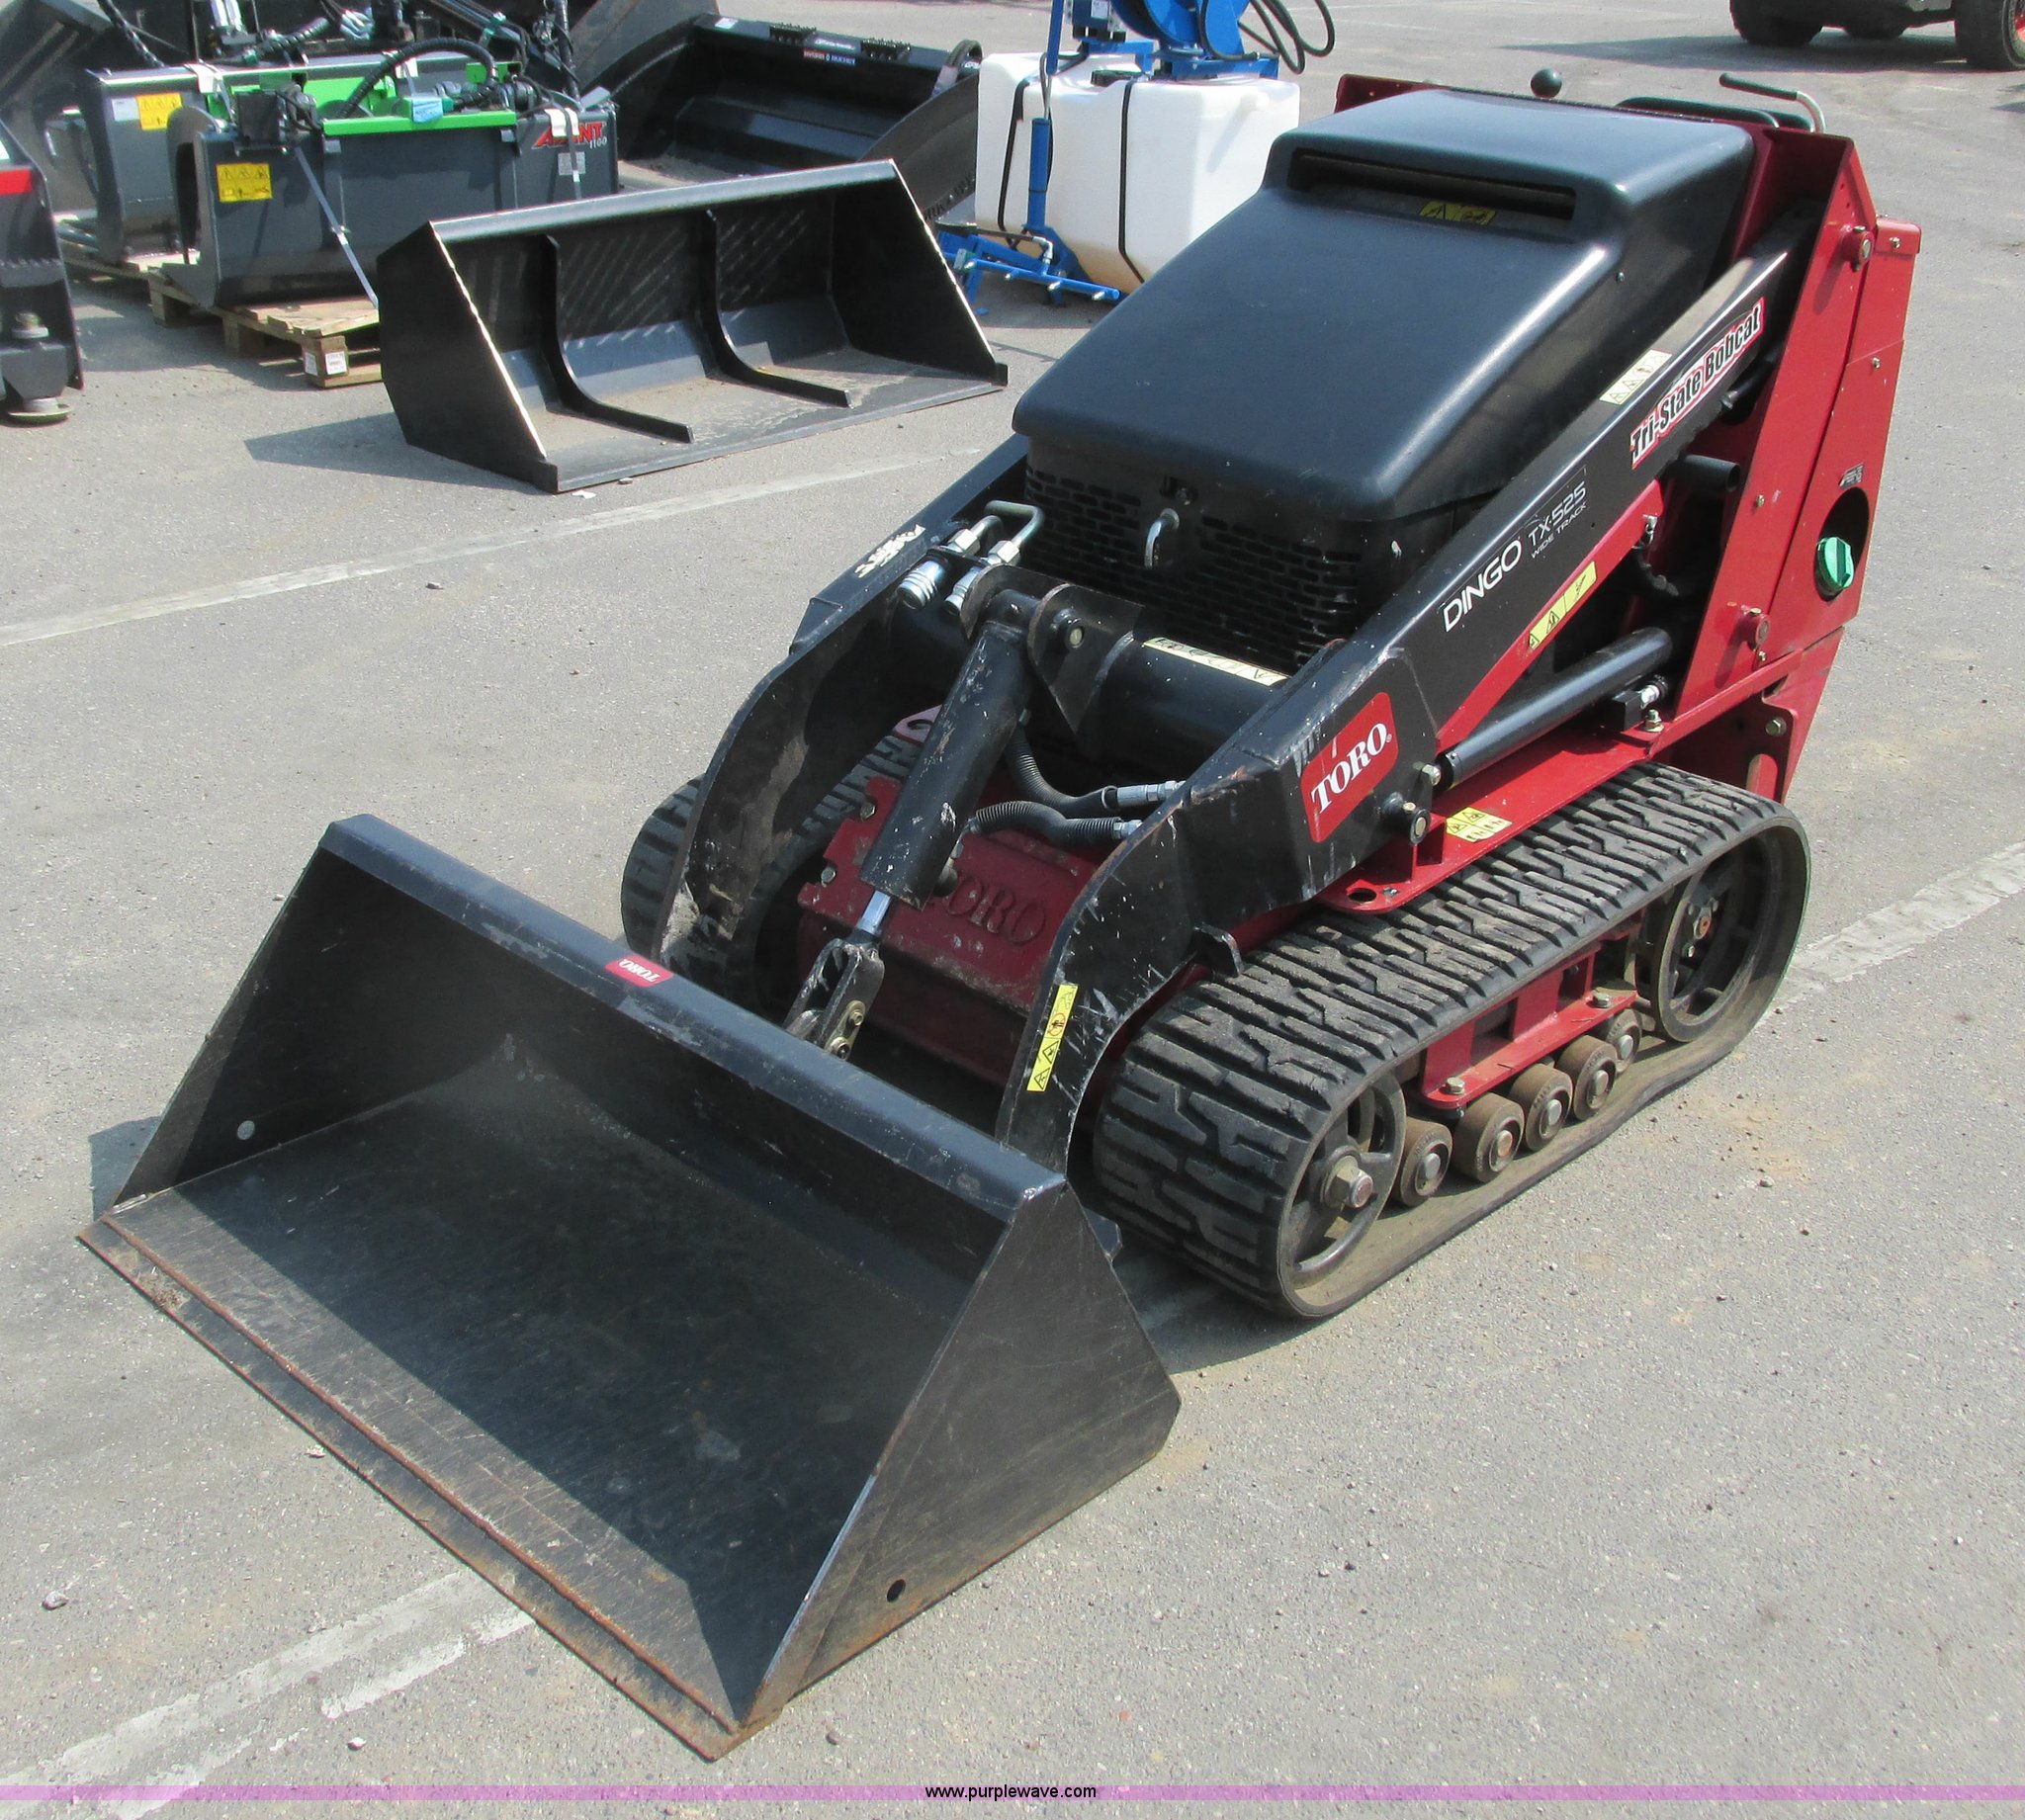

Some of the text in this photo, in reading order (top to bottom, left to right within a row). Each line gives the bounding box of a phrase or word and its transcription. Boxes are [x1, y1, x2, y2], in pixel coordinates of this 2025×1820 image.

[589, 136, 607, 149] 1100
[1632, 303, 1761, 459] Tri-State Bobcat
[1531, 501, 1587, 559] WIDE TRACK
[1443, 539, 1522, 633] DINGO
[1310, 723, 1388, 815] TORO
[927, 874, 1047, 946] ORO
[618, 958, 661, 983] TORO
